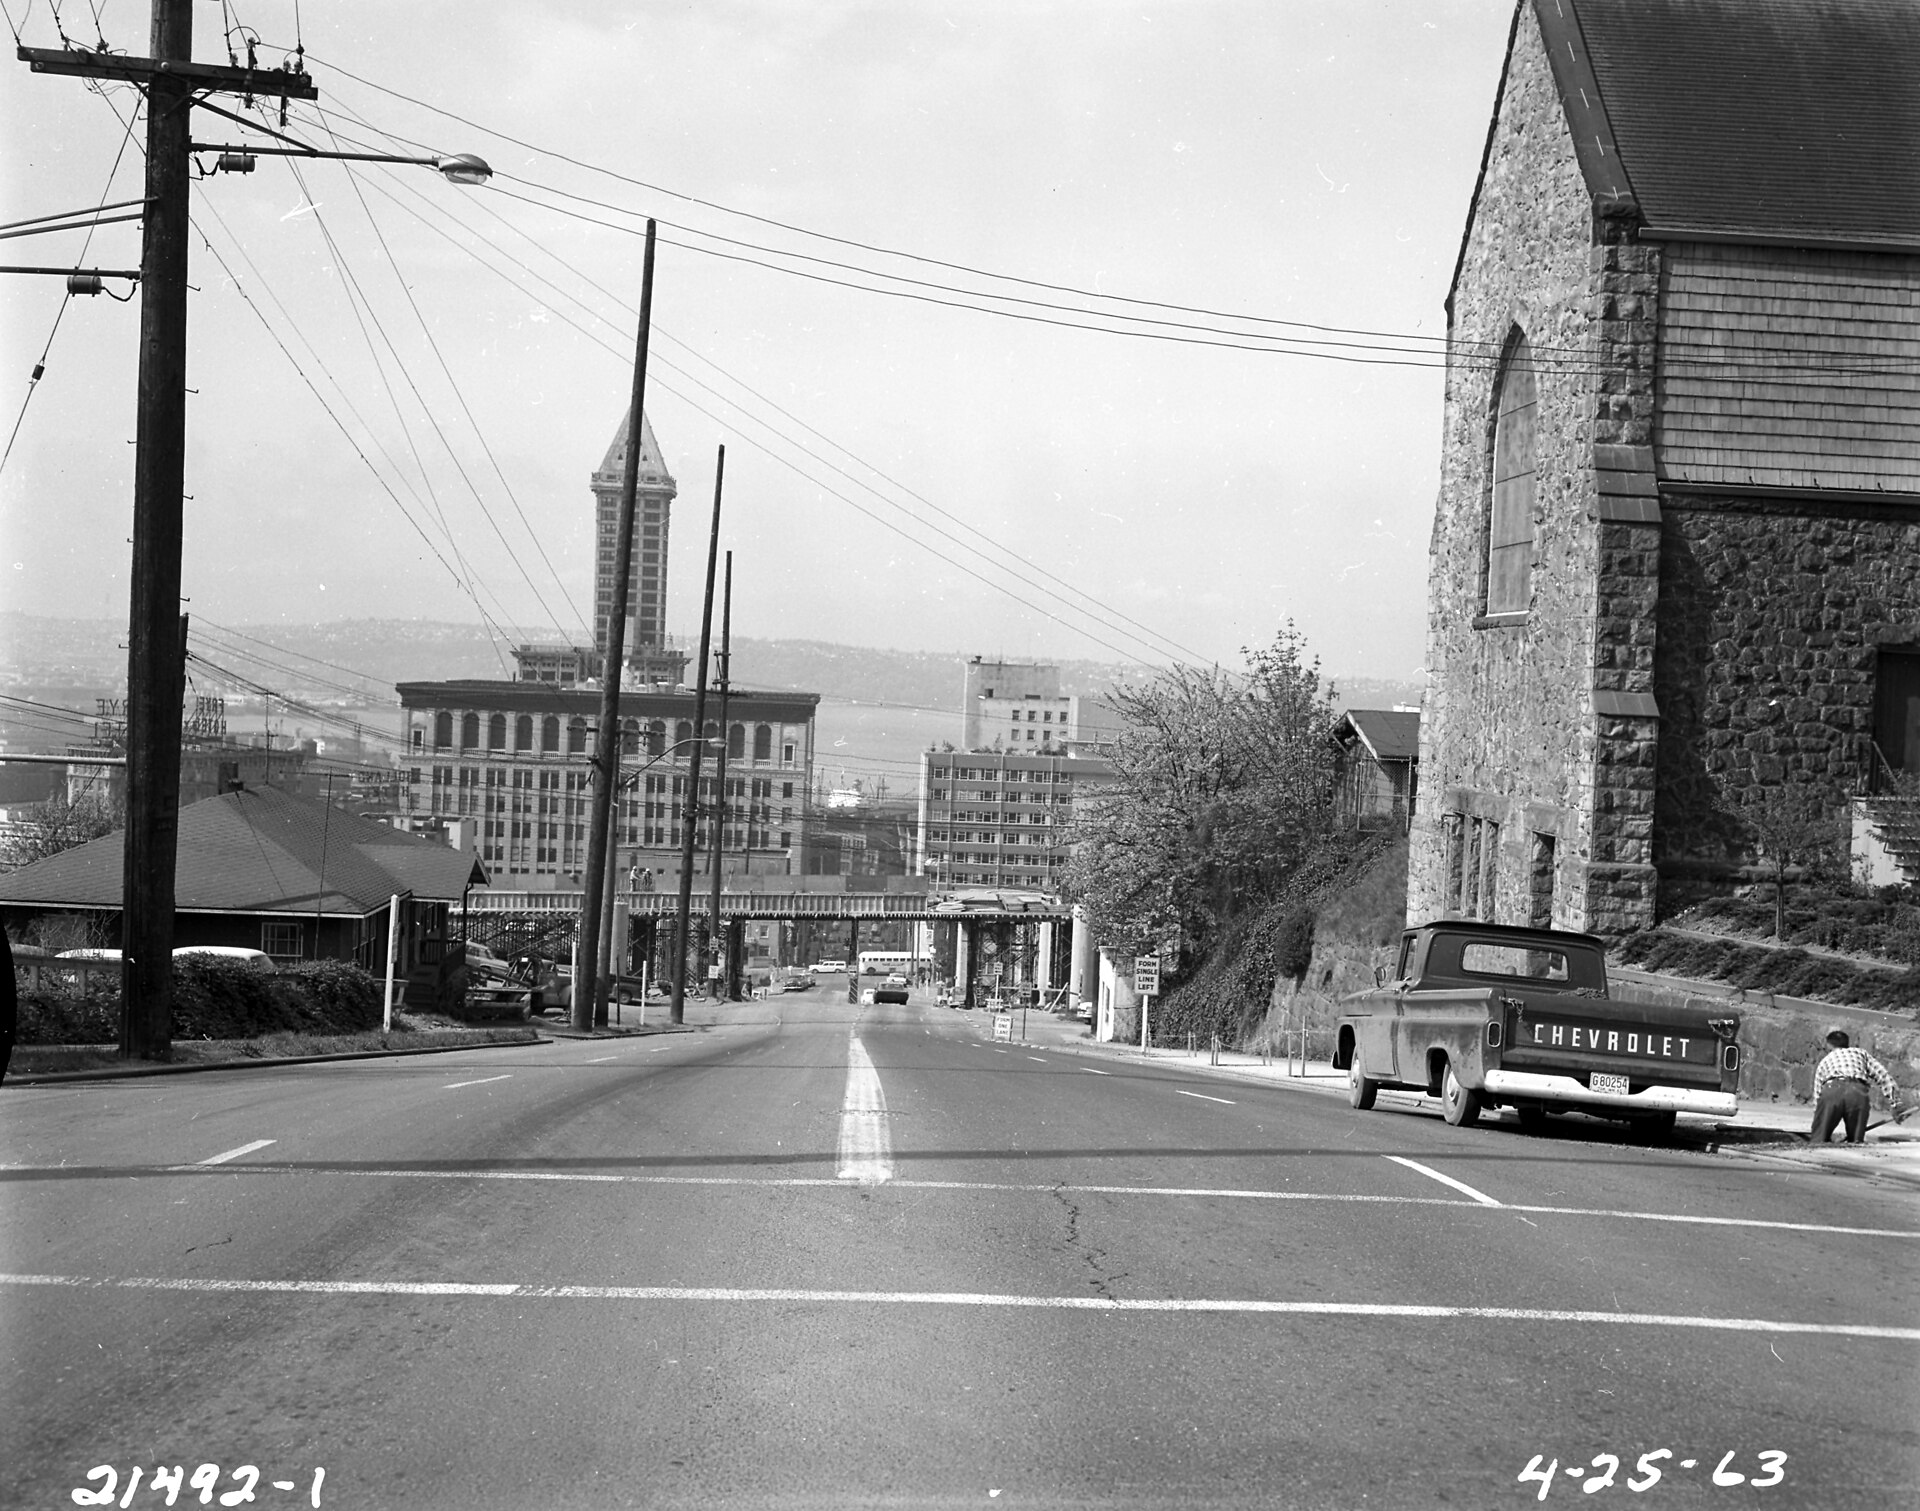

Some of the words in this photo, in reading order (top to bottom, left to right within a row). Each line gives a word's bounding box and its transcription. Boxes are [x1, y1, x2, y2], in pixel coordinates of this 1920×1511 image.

[1138, 960, 1157, 968] FORM
[1136, 968, 1158, 976] SINGLE
[1534, 1023, 1690, 1058] CHEVROLET
[1592, 1075, 1628, 1089] G80254
